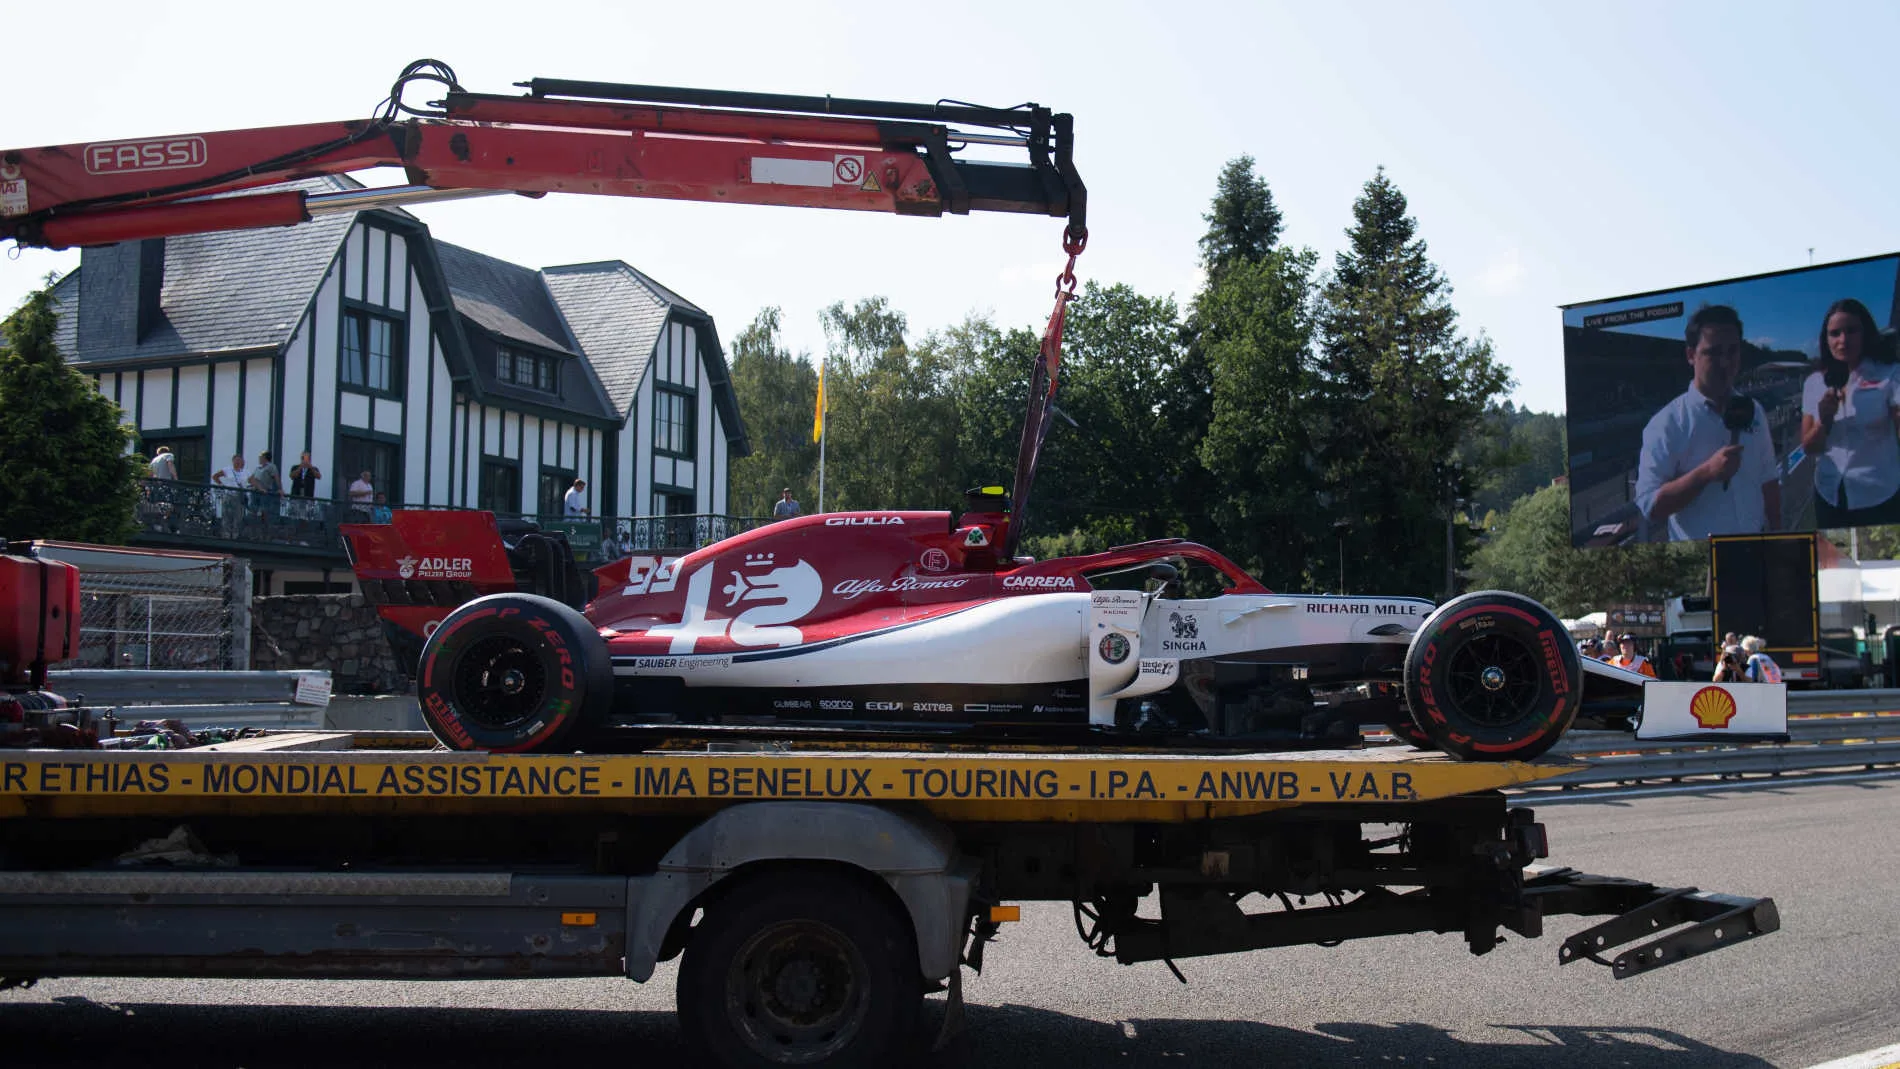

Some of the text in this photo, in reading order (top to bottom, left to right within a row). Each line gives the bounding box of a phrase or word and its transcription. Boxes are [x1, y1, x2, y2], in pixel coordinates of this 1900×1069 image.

[93, 141, 198, 170] FASSI
[1605, 313, 1628, 324] FROM
[1629, 310, 1645, 320] THE
[1647, 305, 1679, 317] PODIUM
[825, 516, 905, 527] GIULIA
[418, 557, 472, 571] ADLER
[446, 570, 472, 578] GROUP
[622, 556, 686, 596] 99
[1002, 576, 1076, 588] CARRERA
[832, 576, 969, 600] Alfa Romeo
[1307, 603, 1417, 615] RICHARD MILLE
[528, 616, 575, 690] ZERO
[1162, 640, 1207, 651] SINGHA
[638, 657, 729, 670] SAUBER Engineering
[1420, 642, 1447, 724] ZERO
[40, 763, 170, 792] ETHIAS
[203, 764, 368, 794] MONDIAL
[376, 766, 600, 795] ASSISTANCE
[634, 767, 697, 795] IMA
[708, 767, 873, 797] BENELUX
[902, 769, 1059, 798] TOURING
[1090, 770, 1166, 799] I.P.A.
[1195, 771, 1299, 799] ANWB
